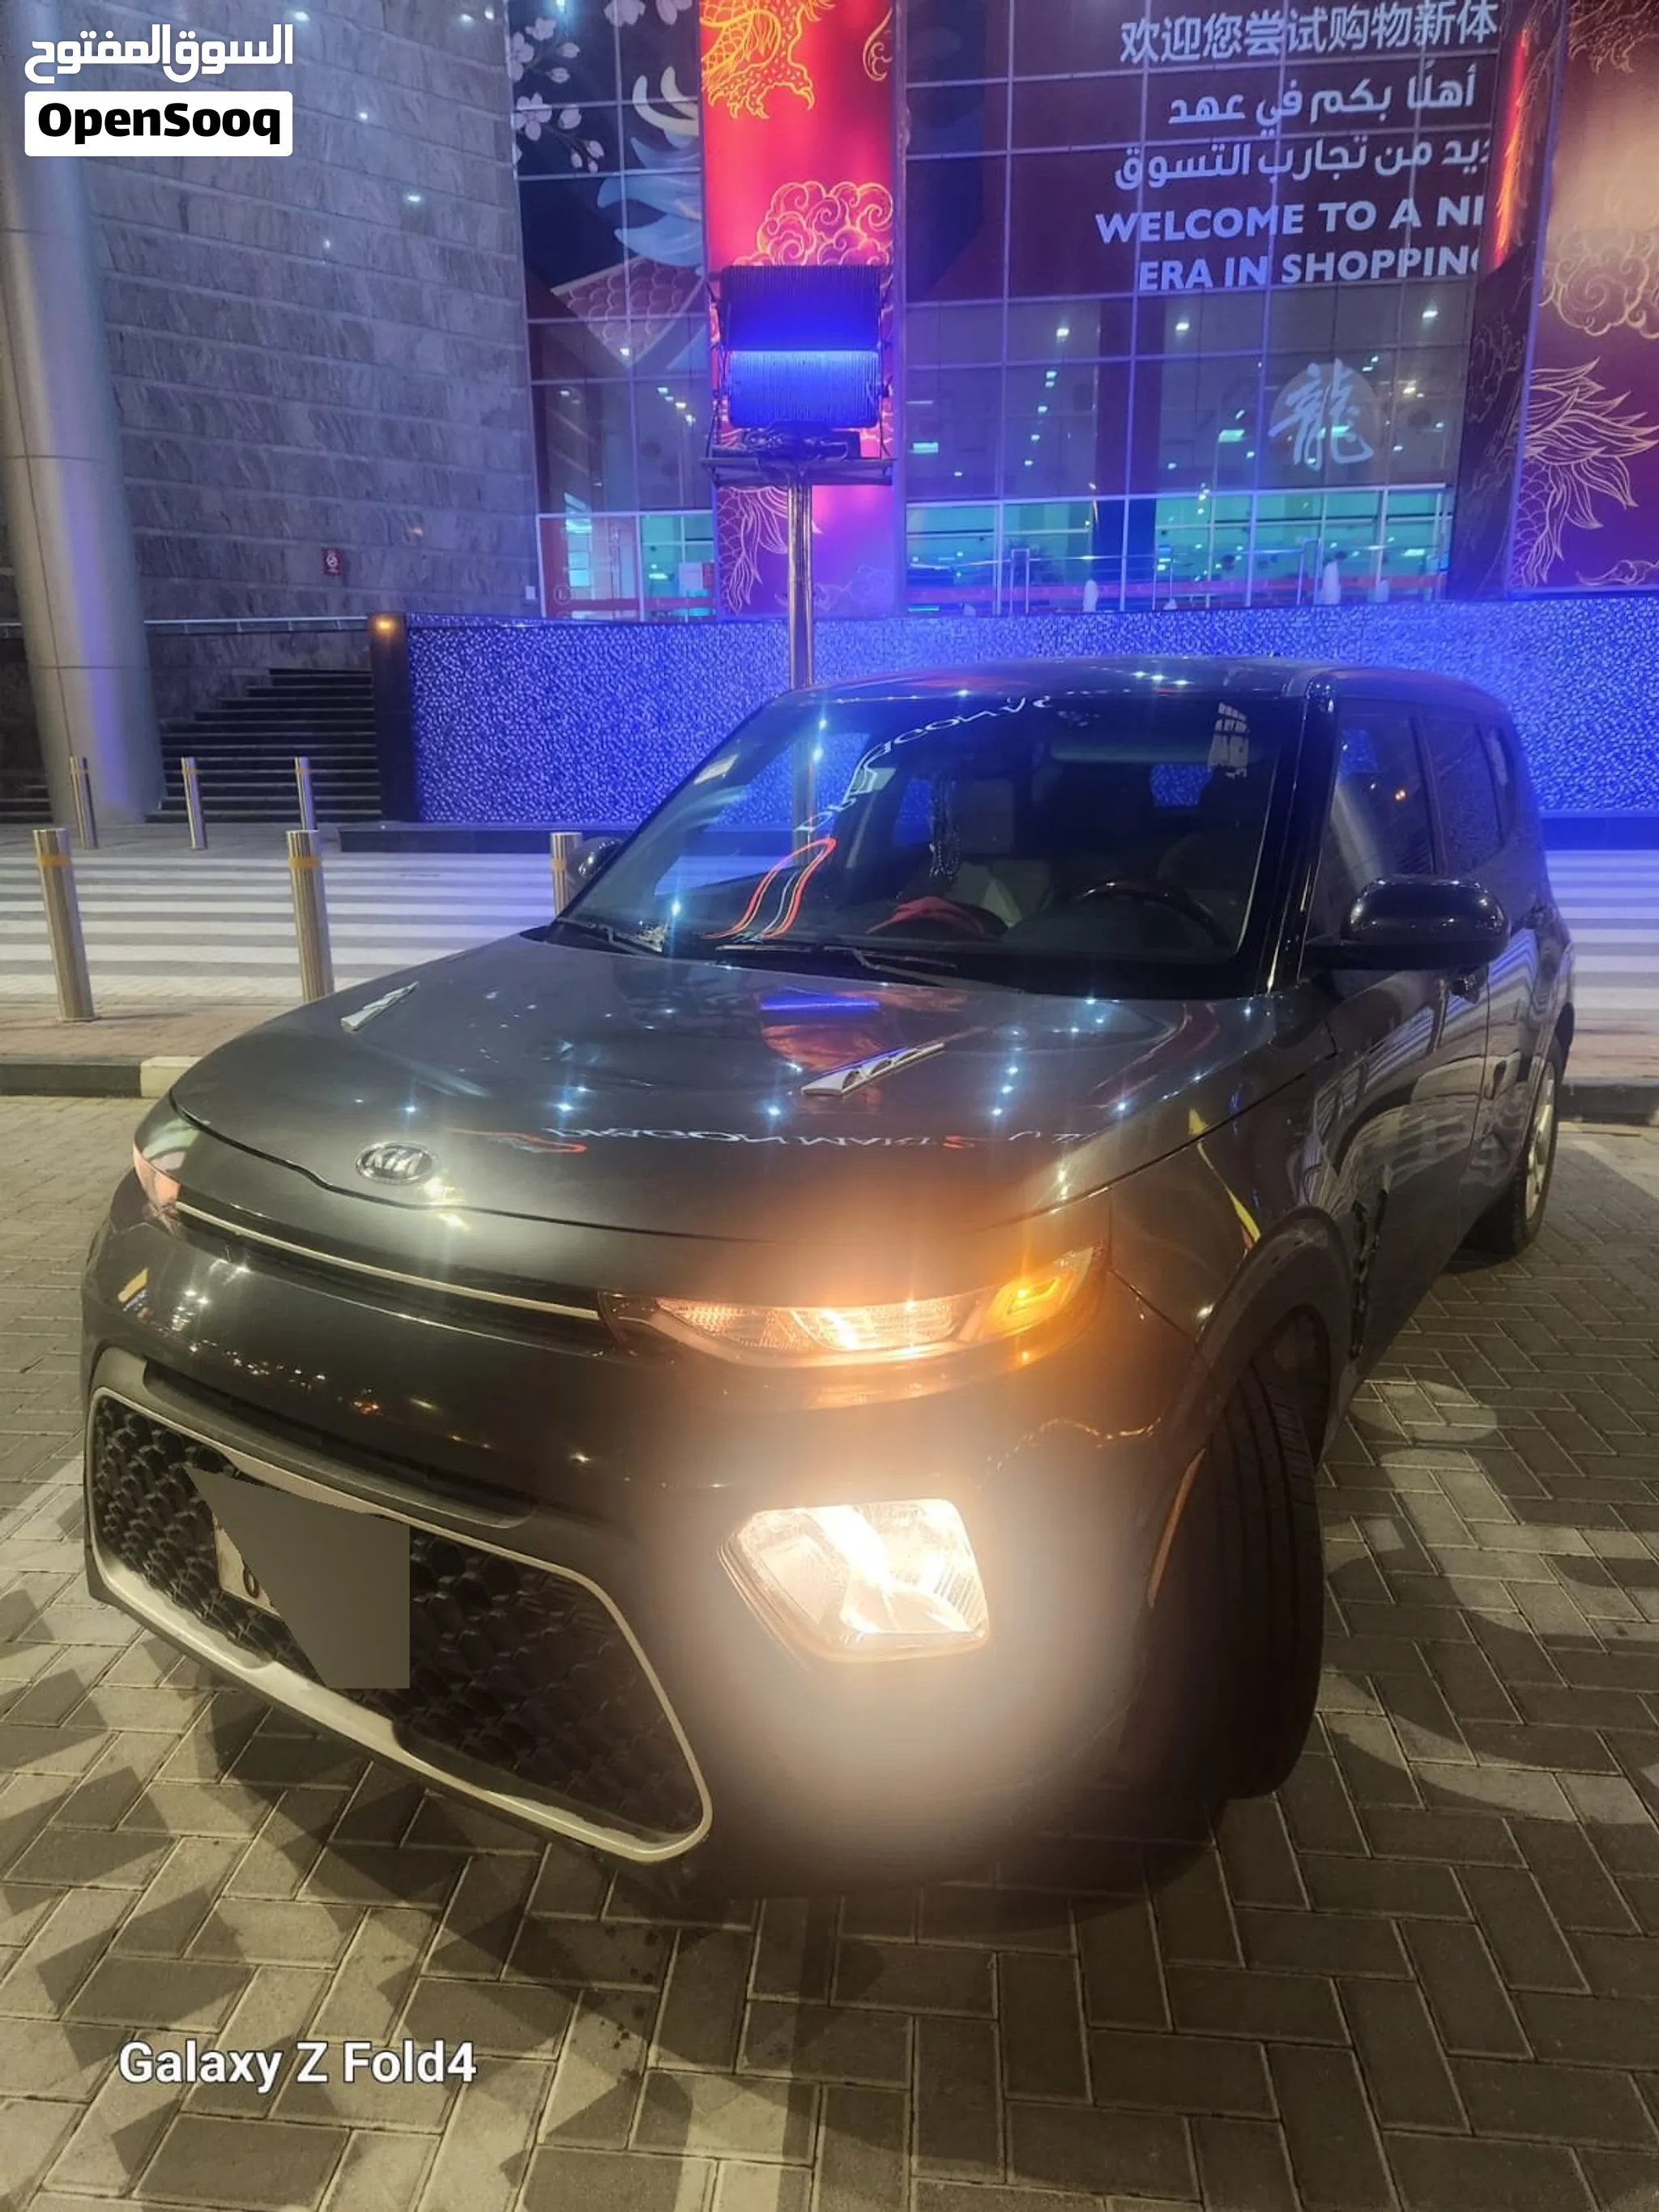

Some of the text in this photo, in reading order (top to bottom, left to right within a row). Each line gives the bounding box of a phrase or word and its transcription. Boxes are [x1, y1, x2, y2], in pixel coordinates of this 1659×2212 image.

[1120, 0, 1498, 63] 欢迎您尝试购物新体
[1168, 93, 1246, 125] عهد
[1256, 79, 1303, 136] في
[1310, 78, 1392, 121] بكم
[1115, 143, 1251, 190] التسوق
[1258, 136, 1367, 181] تجارب
[1375, 141, 1433, 176] من
[1095, 202, 1304, 244] WELCOME
[1318, 200, 1377, 232] TO
[1388, 198, 1422, 231] A
[1138, 258, 1213, 292] ERA
[1224, 255, 1269, 288] IN
